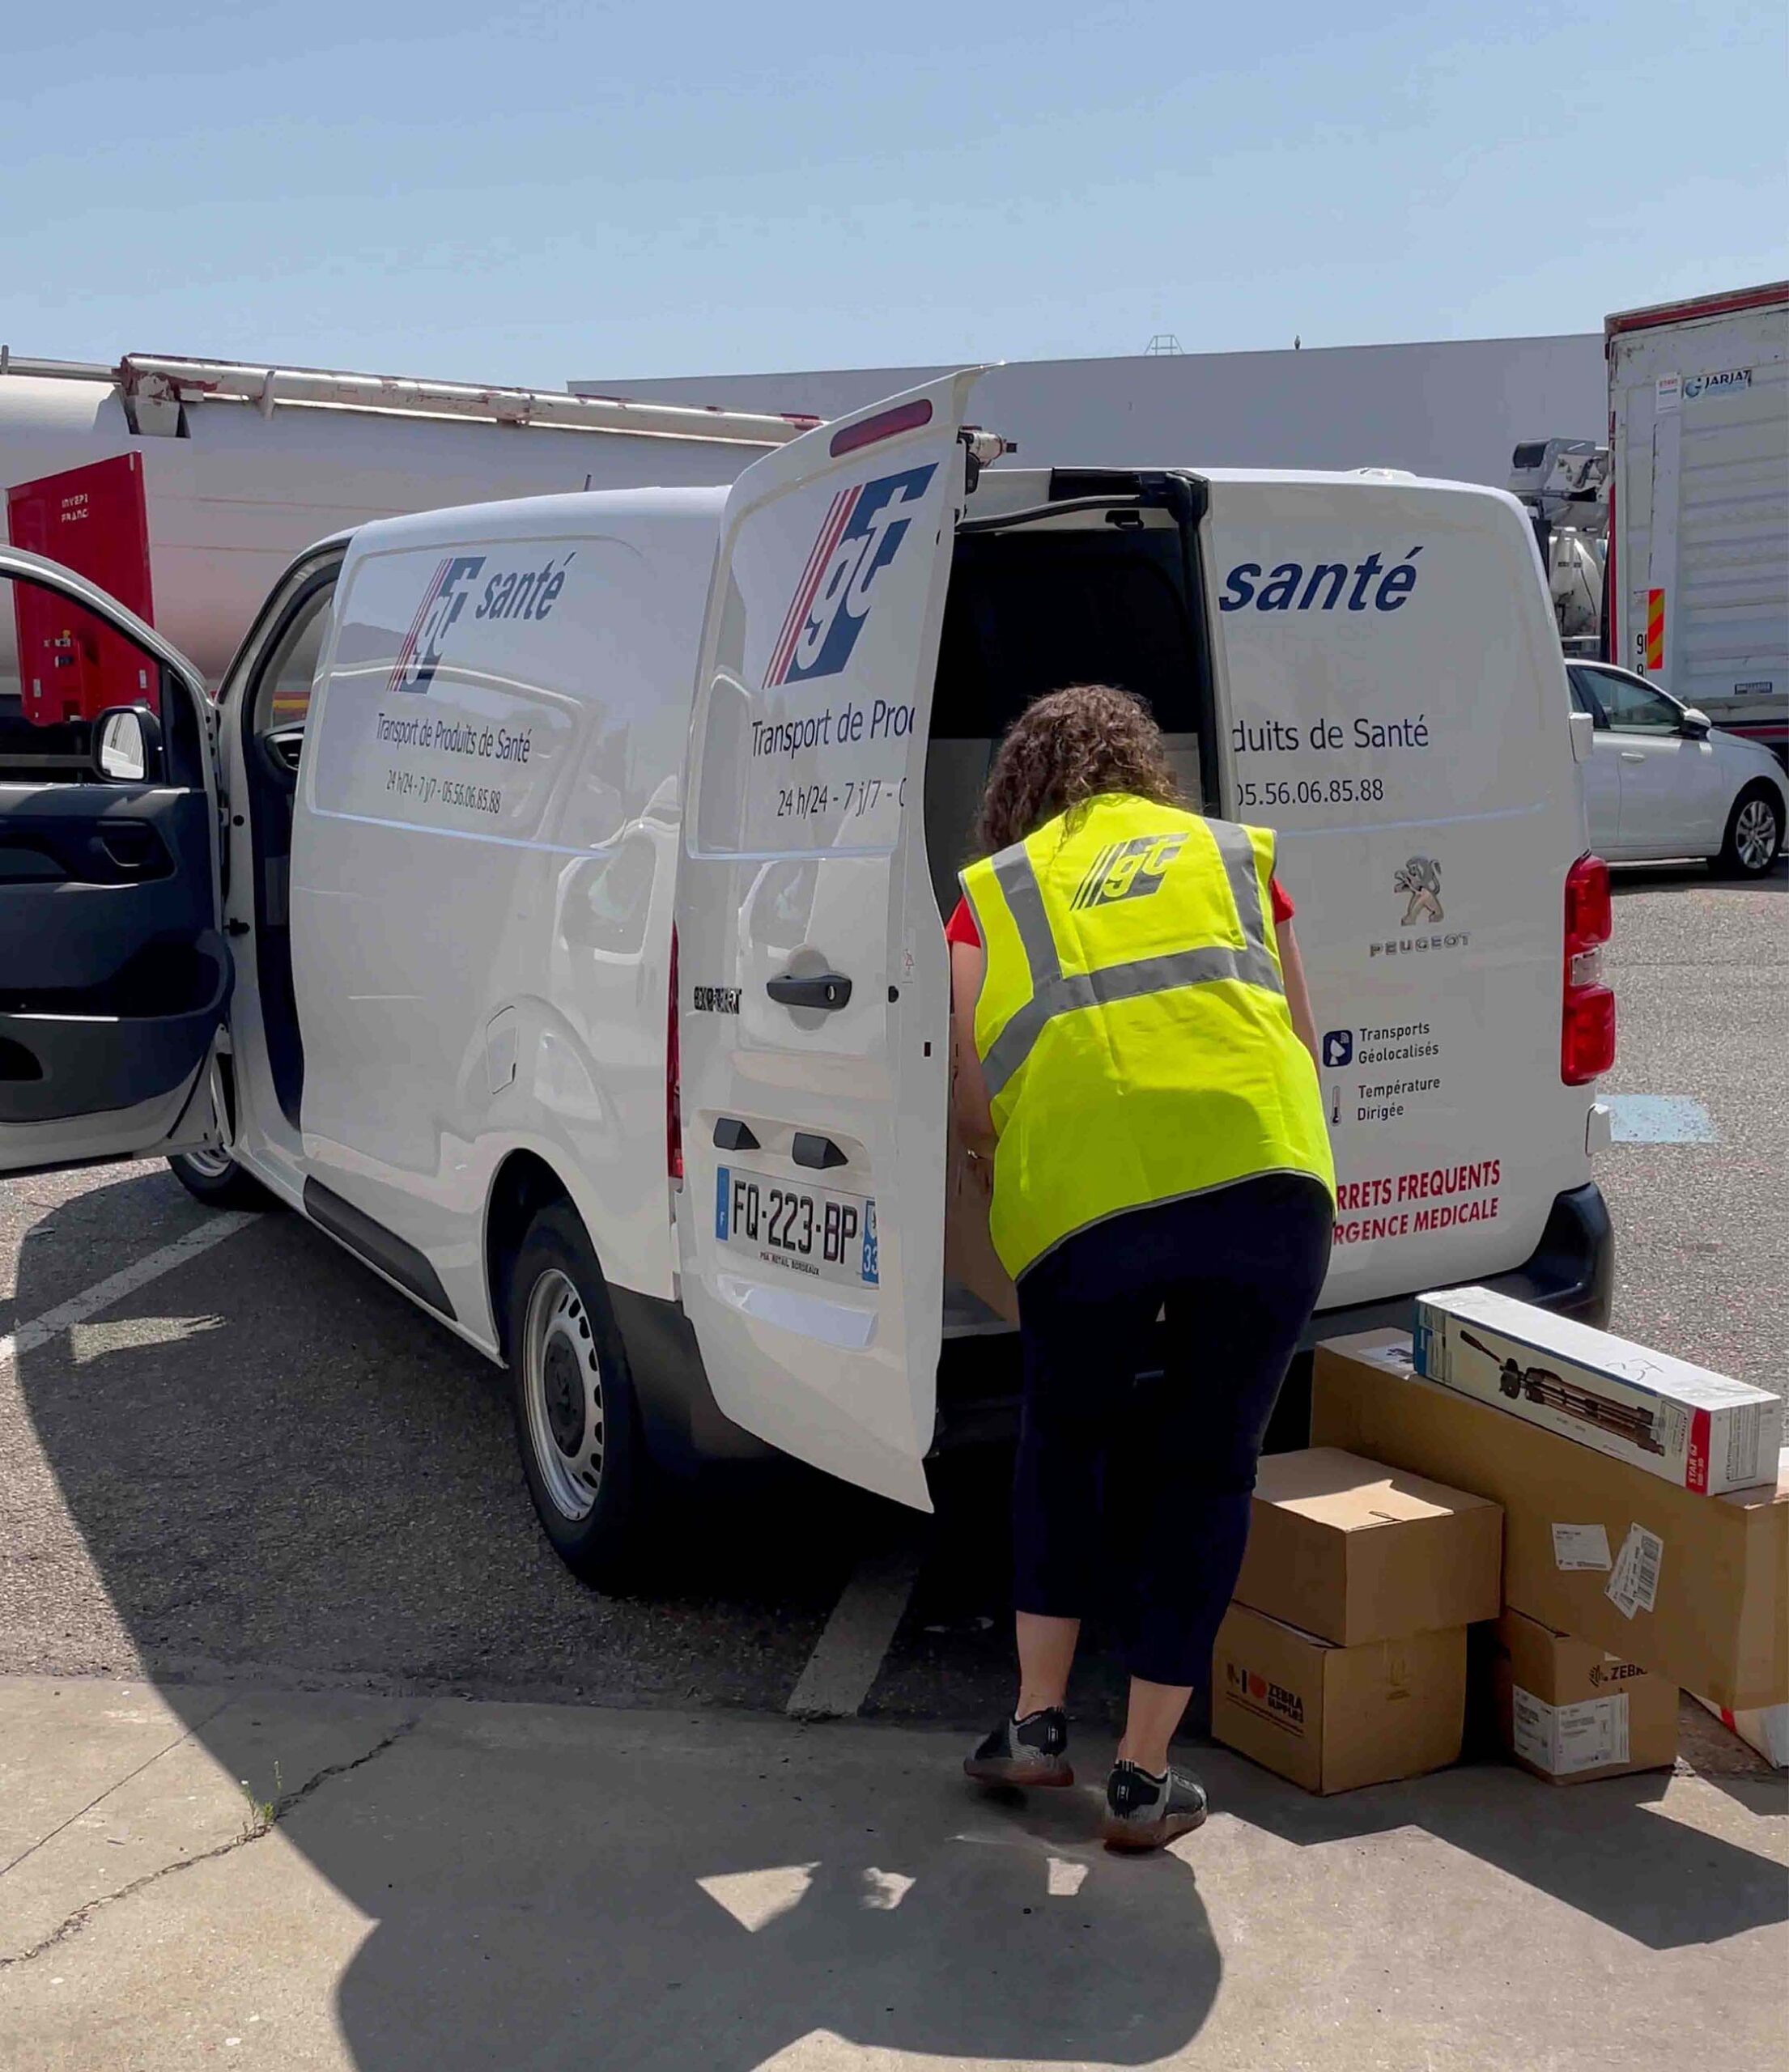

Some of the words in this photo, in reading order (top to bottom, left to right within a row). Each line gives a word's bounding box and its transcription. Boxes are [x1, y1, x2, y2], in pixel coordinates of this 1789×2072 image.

[475, 551, 576, 621] santé
[1218, 546, 1424, 612] santé
[376, 713, 419, 750] Transport
[419, 719, 432, 747] de
[434, 720, 477, 755] Produits
[478, 726, 494, 758] de
[495, 728, 533, 763] Santé
[752, 708, 832, 759] Transport
[837, 702, 864, 744] de
[1310, 718, 1344, 749] de
[1353, 714, 1429, 749] Santé
[777, 789, 793, 817] 24
[797, 785, 829, 820] h/24
[844, 782, 855, 810] 7
[1370, 932, 1471, 957] PEUGEOT
[1358, 1041, 1439, 1064] Géolocalisés
[1359, 1022, 1430, 1042] Transports
[1358, 1078, 1441, 1098] Température
[1358, 1102, 1404, 1121] Dirigée
[1336, 1178, 1392, 1212] RRETS
[1397, 1159, 1501, 1203] FREQUENTS
[733, 1179, 858, 1265] FQ-223-BP
[1332, 1214, 1409, 1245] RGENCE
[1413, 1197, 1499, 1233] MEDICALE
